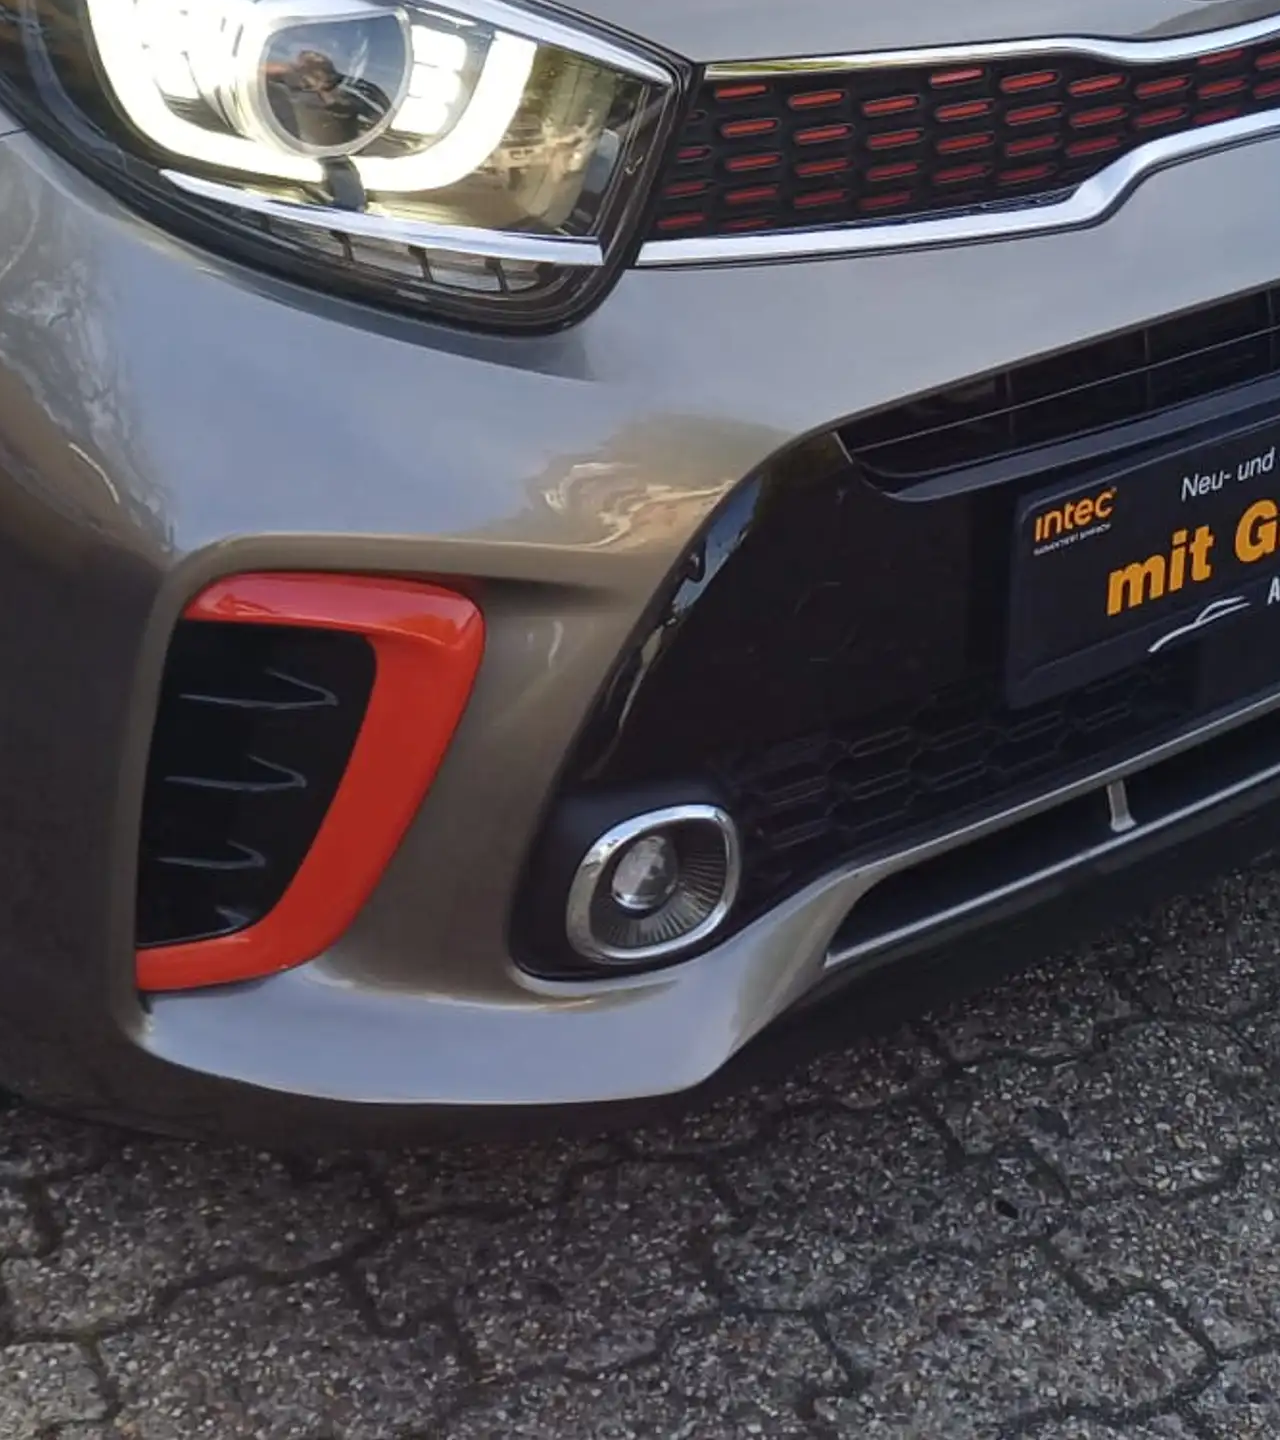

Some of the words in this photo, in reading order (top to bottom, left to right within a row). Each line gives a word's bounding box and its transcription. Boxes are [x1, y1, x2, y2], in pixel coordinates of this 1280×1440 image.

[1181, 472, 1231, 502] Neu-
[1237, 447, 1275, 482] und
[1034, 491, 1113, 542] intec
[1106, 524, 1215, 616] mit
